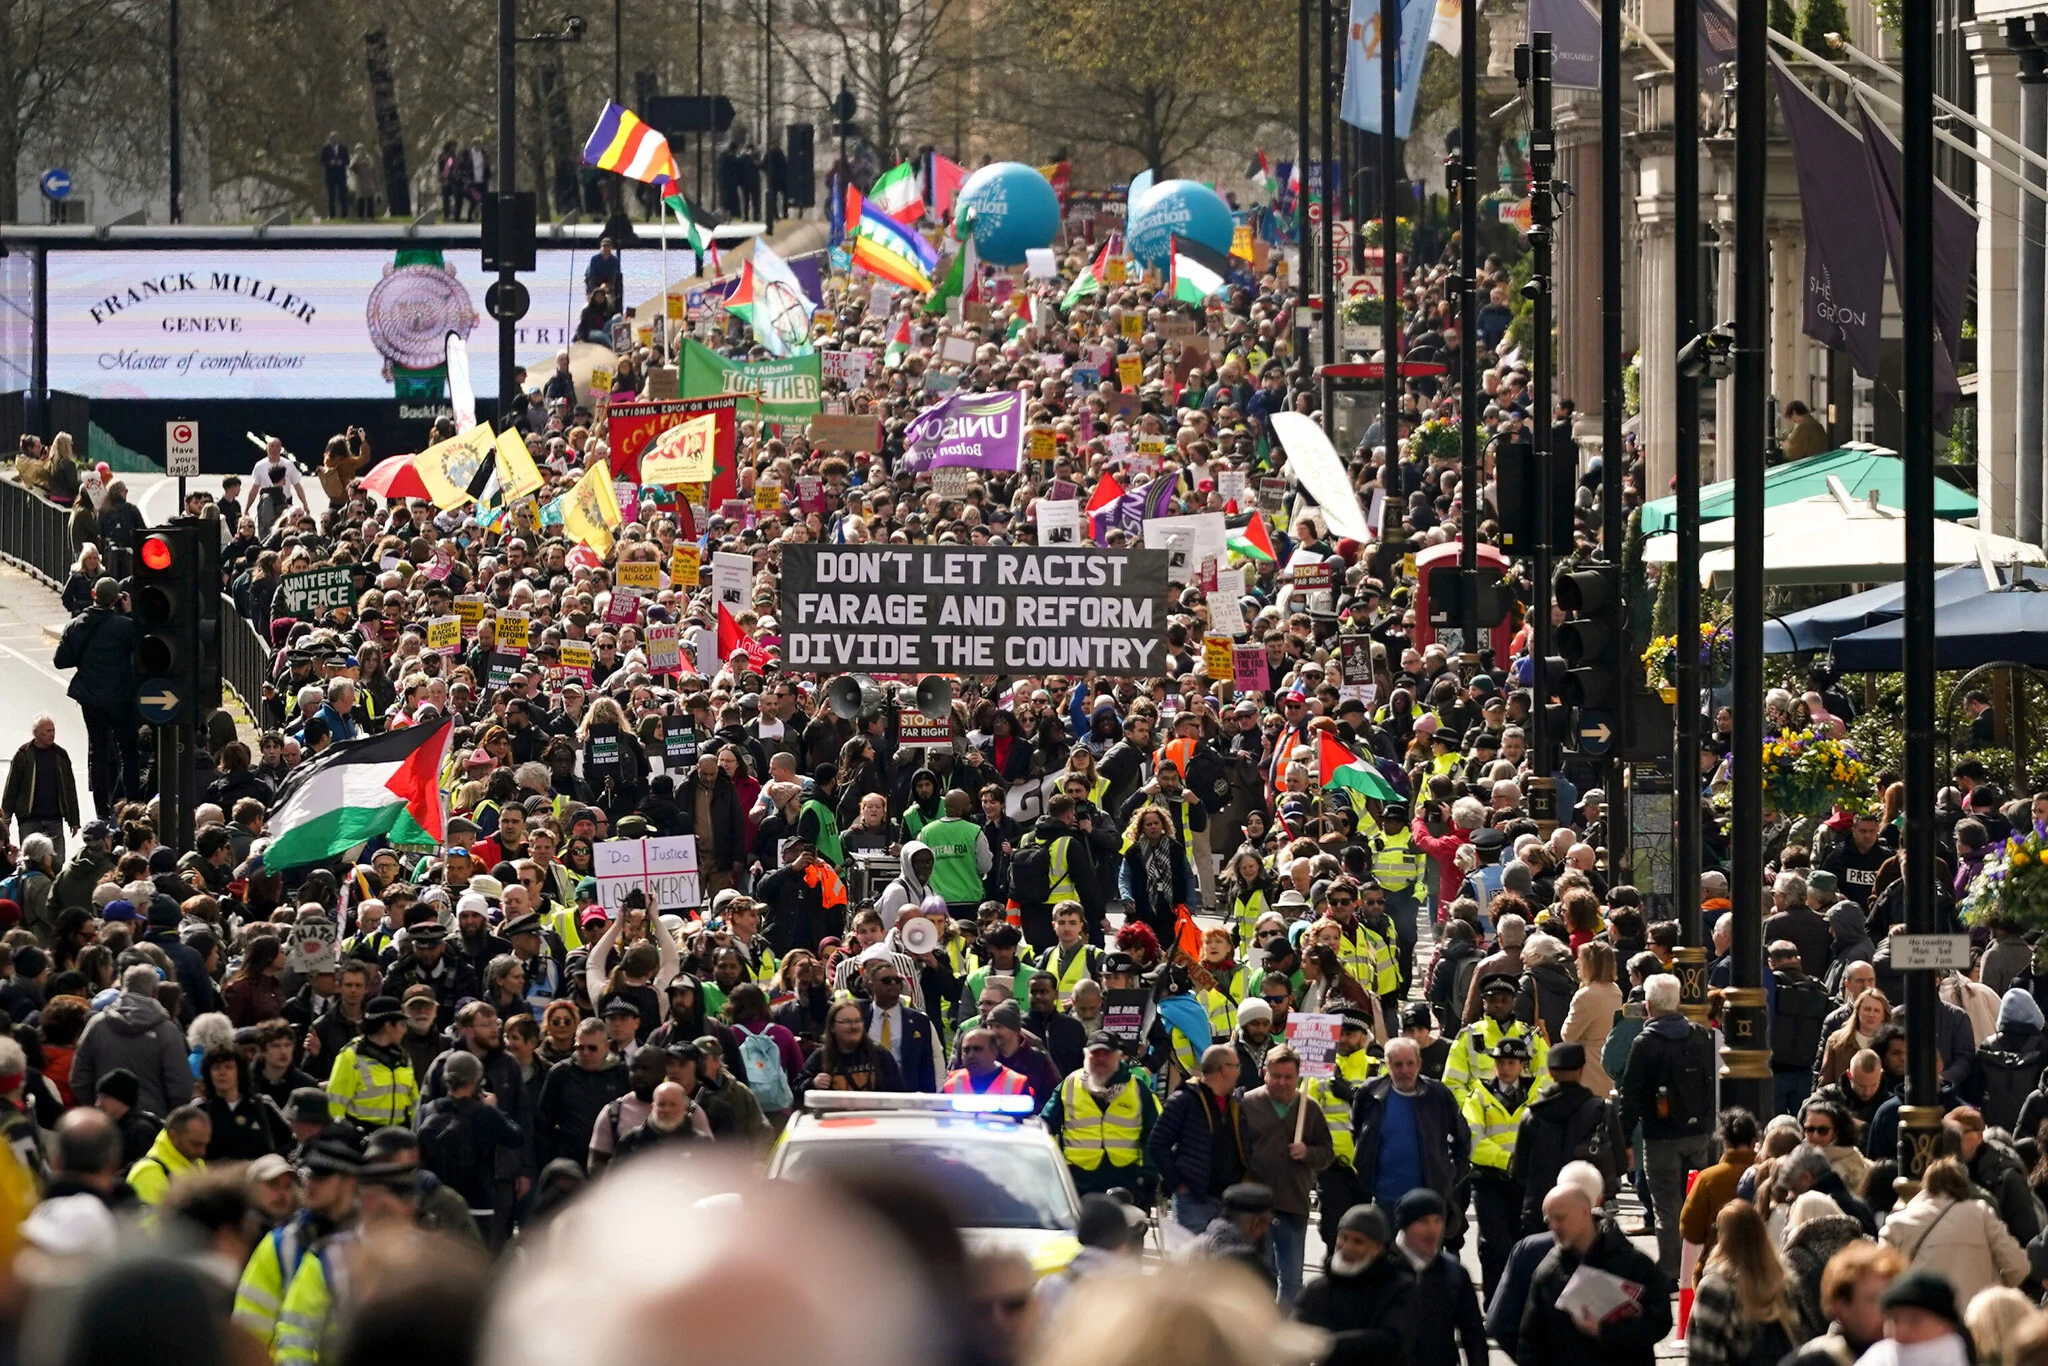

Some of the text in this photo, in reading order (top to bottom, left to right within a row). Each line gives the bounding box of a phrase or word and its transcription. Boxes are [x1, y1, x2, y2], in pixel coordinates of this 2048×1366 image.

[88, 272, 316, 325] FRANCK MULLER
[162, 317, 242, 332] GENEVE
[98, 349, 305, 376] Master of complications
[757, 364, 794, 375] Albans
[611, 406, 657, 417] NATIONAL
[707, 398, 736, 409] UNION
[172, 446, 194, 454] Have
[644, 566, 658, 574] OFF
[923, 554, 987, 585] LET
[998, 555, 1128, 586] RACIST
[1294, 566, 1318, 577] STOP
[623, 574, 654, 582] AL-AQSA
[1294, 576, 1329, 586] FAR RIGHT
[295, 586, 349, 612] PEACE
[455, 603, 477, 611] Oppose
[798, 593, 1152, 628] FARAGE AND REFORM
[436, 622, 453, 630] STOP
[432, 627, 456, 636] RACIST
[498, 631, 526, 639] REFORM
[650, 627, 675, 640] LOVE
[431, 632, 458, 641] REFORM
[563, 648, 590, 657] Refugees
[789, 633, 1158, 669] DIVIDE THE COUNTRY
[1236, 651, 1260, 659] SMASH
[563, 657, 589, 665] welcome
[651, 652, 678, 667] HATE
[1238, 660, 1264, 668] THE FAR
[493, 665, 517, 673] WE ARE
[1239, 669, 1258, 677] RIGHT
[901, 714, 934, 726] STOP
[901, 727, 950, 737] FAR RIGHT
[605, 736, 616, 744] ARE
[651, 846, 689, 861] Justice
[649, 874, 698, 906] MERCY
[1922, 938, 1952, 947] loading
[1935, 957, 1952, 965] 7pm
[1108, 1006, 1140, 1014] WE ARE
